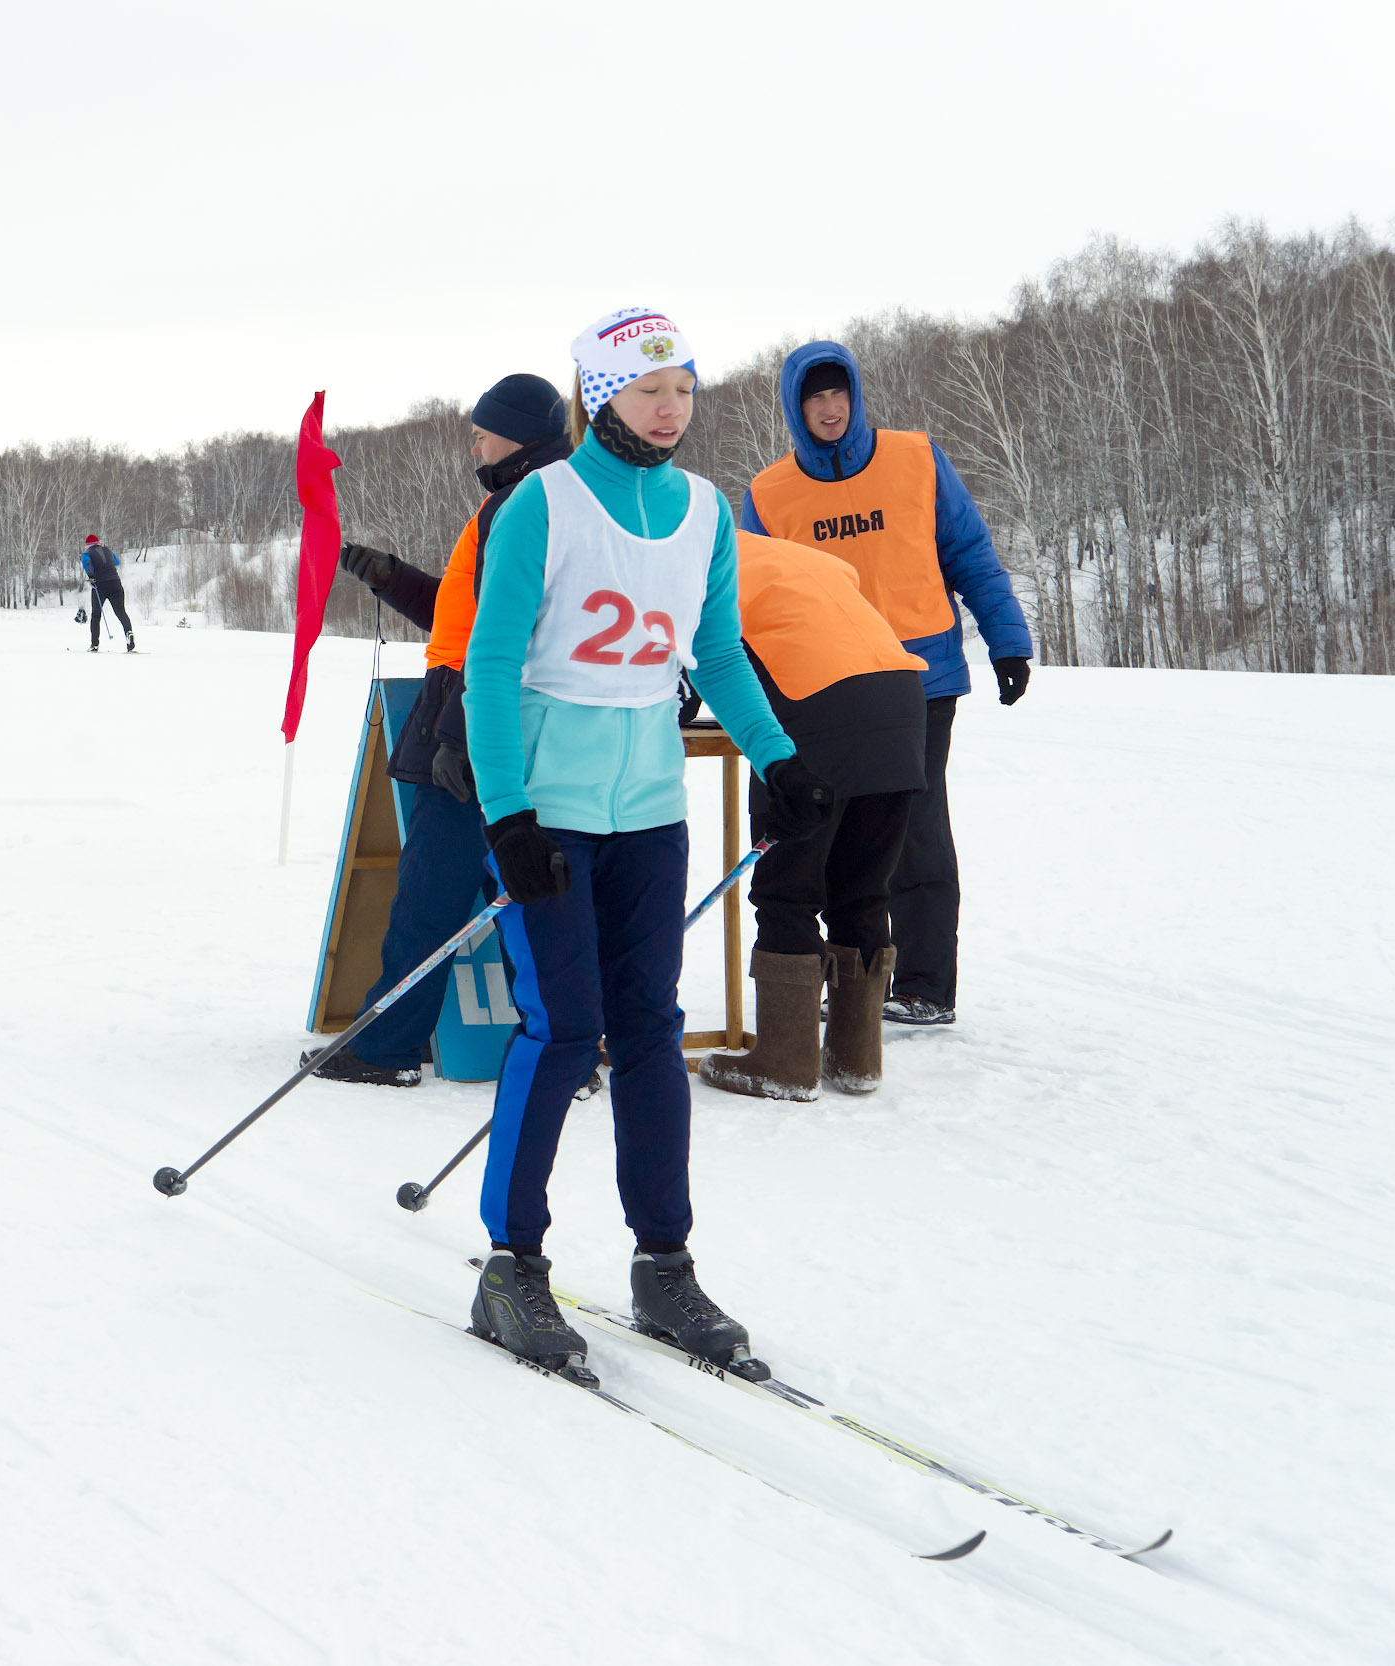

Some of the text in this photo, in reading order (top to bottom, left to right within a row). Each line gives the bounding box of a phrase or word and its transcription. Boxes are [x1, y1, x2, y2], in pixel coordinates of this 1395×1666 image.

[812, 509, 885, 542] СУДЬЯ
[569, 589, 676, 666] 22
[687, 1355, 725, 1382] TISA
